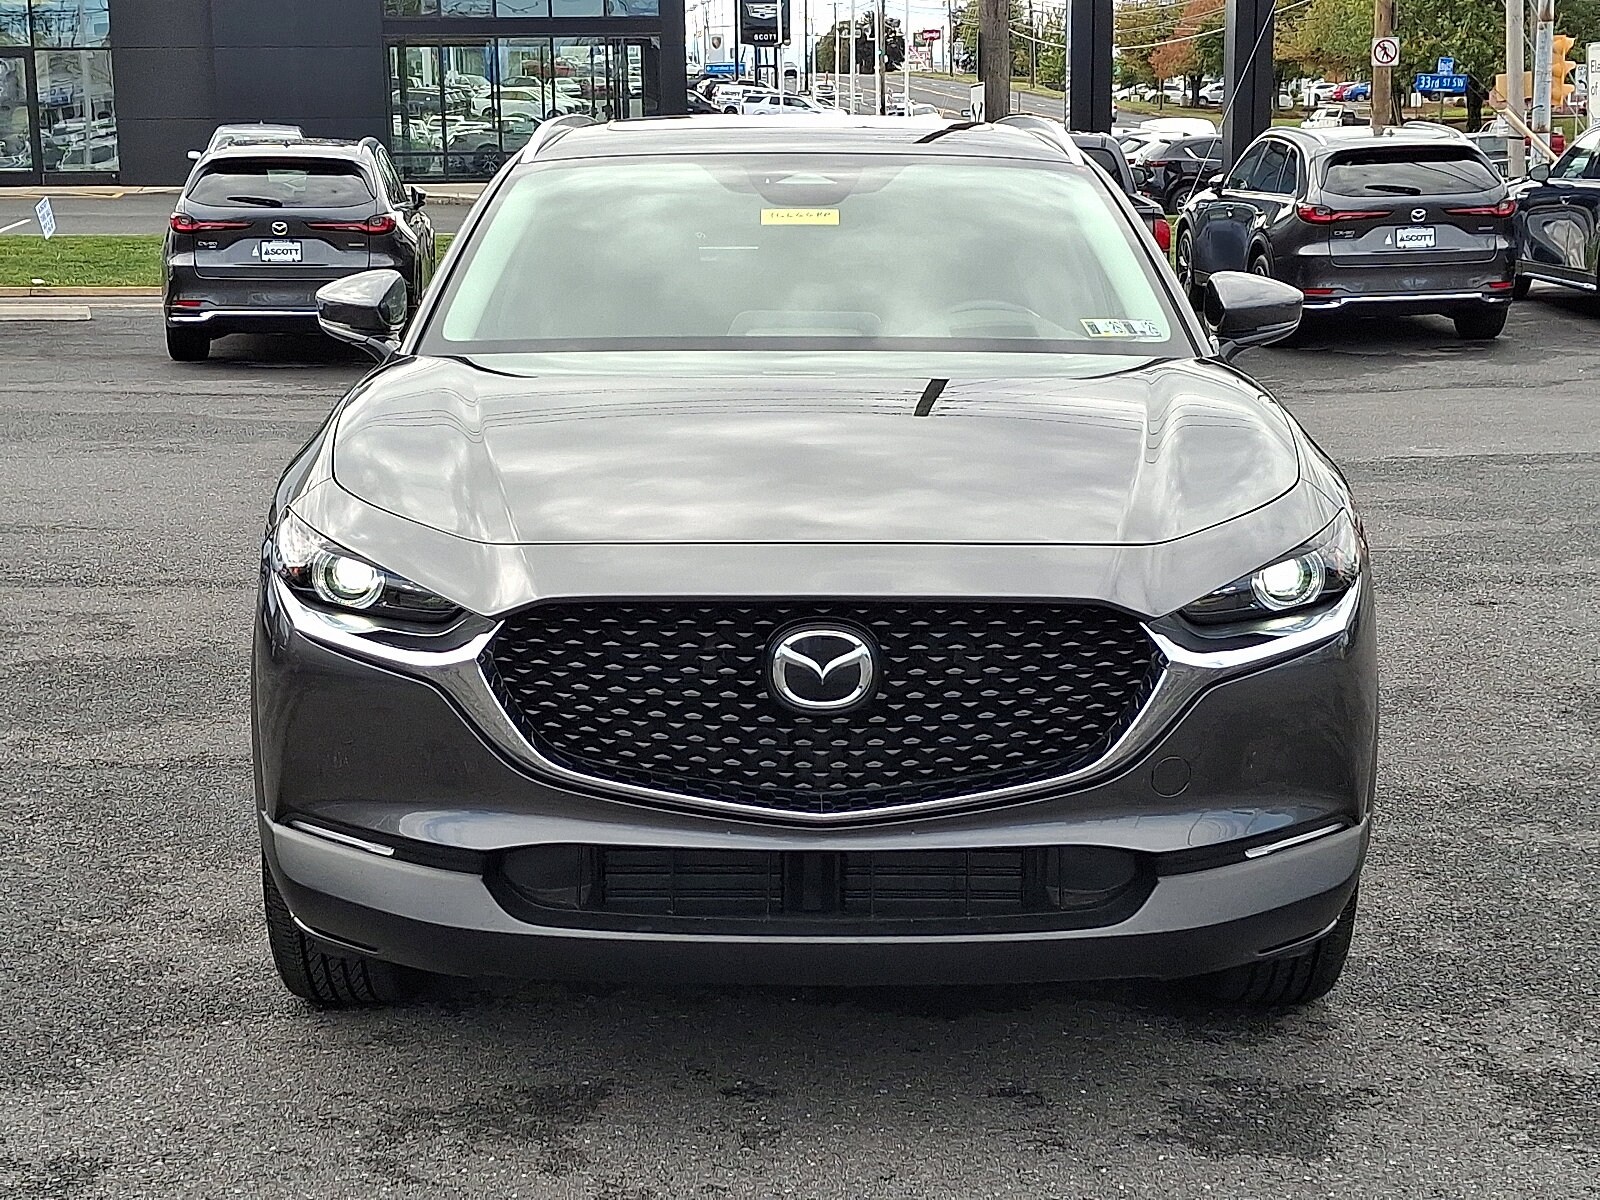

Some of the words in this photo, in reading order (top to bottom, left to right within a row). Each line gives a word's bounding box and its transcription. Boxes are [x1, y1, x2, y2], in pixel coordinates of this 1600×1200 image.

[753, 33, 777, 41] SCOTT
[1419, 75, 1440, 89] 33rd
[1452, 77, 1466, 88] SW
